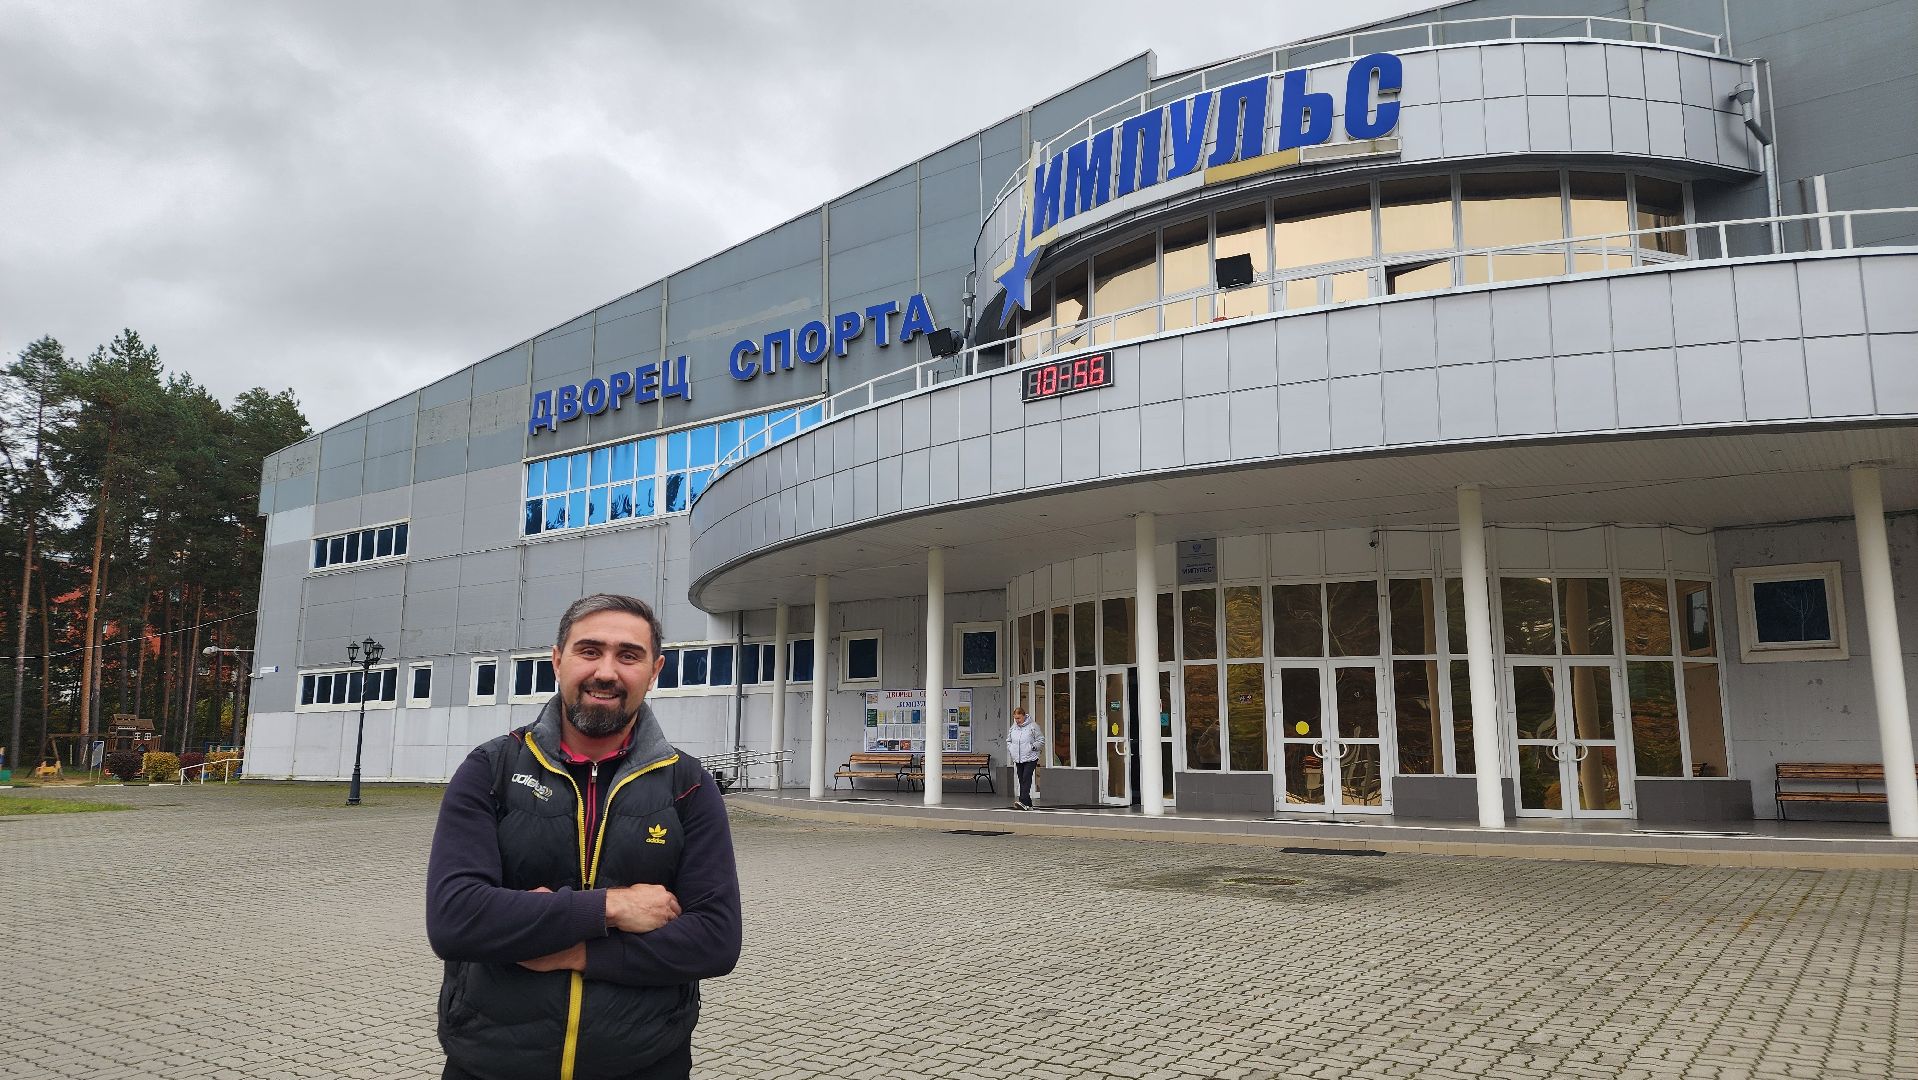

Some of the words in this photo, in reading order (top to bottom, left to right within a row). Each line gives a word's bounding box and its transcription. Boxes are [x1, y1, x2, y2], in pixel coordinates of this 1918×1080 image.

[1032, 52, 1402, 238] ИМПУЛЬС
[529, 355, 691, 436] ДВОРЕЦ
[729, 293, 936, 381] СПОРТА
[645, 837, 666, 845] adidas
